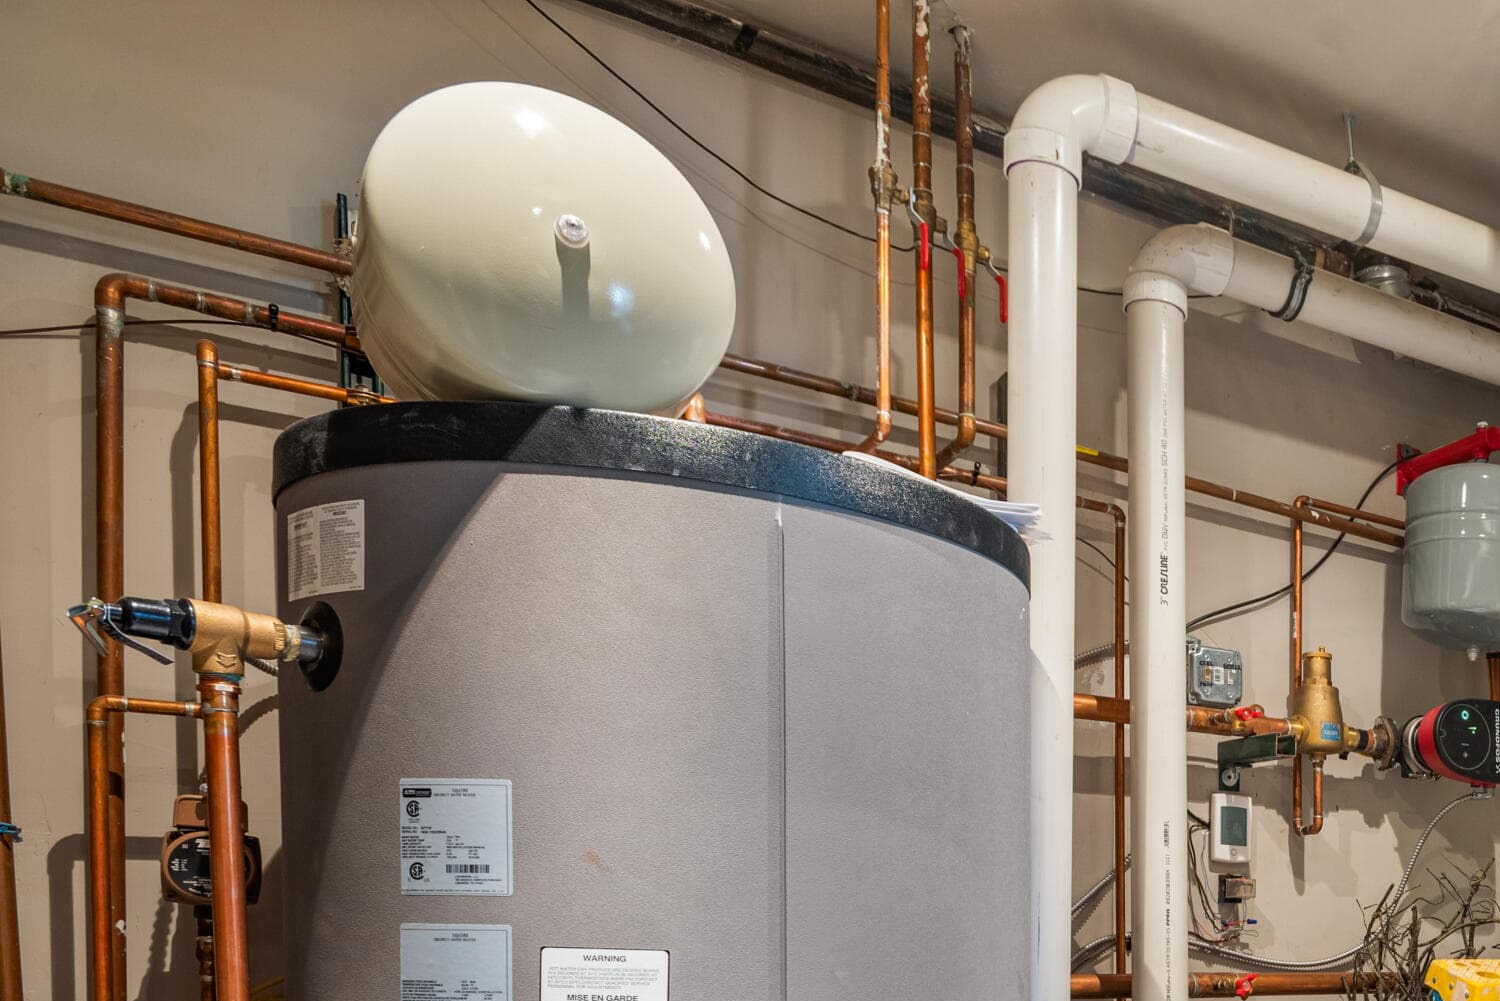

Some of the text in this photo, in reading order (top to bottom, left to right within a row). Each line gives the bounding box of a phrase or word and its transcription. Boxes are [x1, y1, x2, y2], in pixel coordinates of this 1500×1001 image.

[1161, 439, 1168, 450] 40
[583, 954, 627, 963] WARNING
[567, 993, 589, 1001] MISE
[591, 994, 604, 1001] EN
